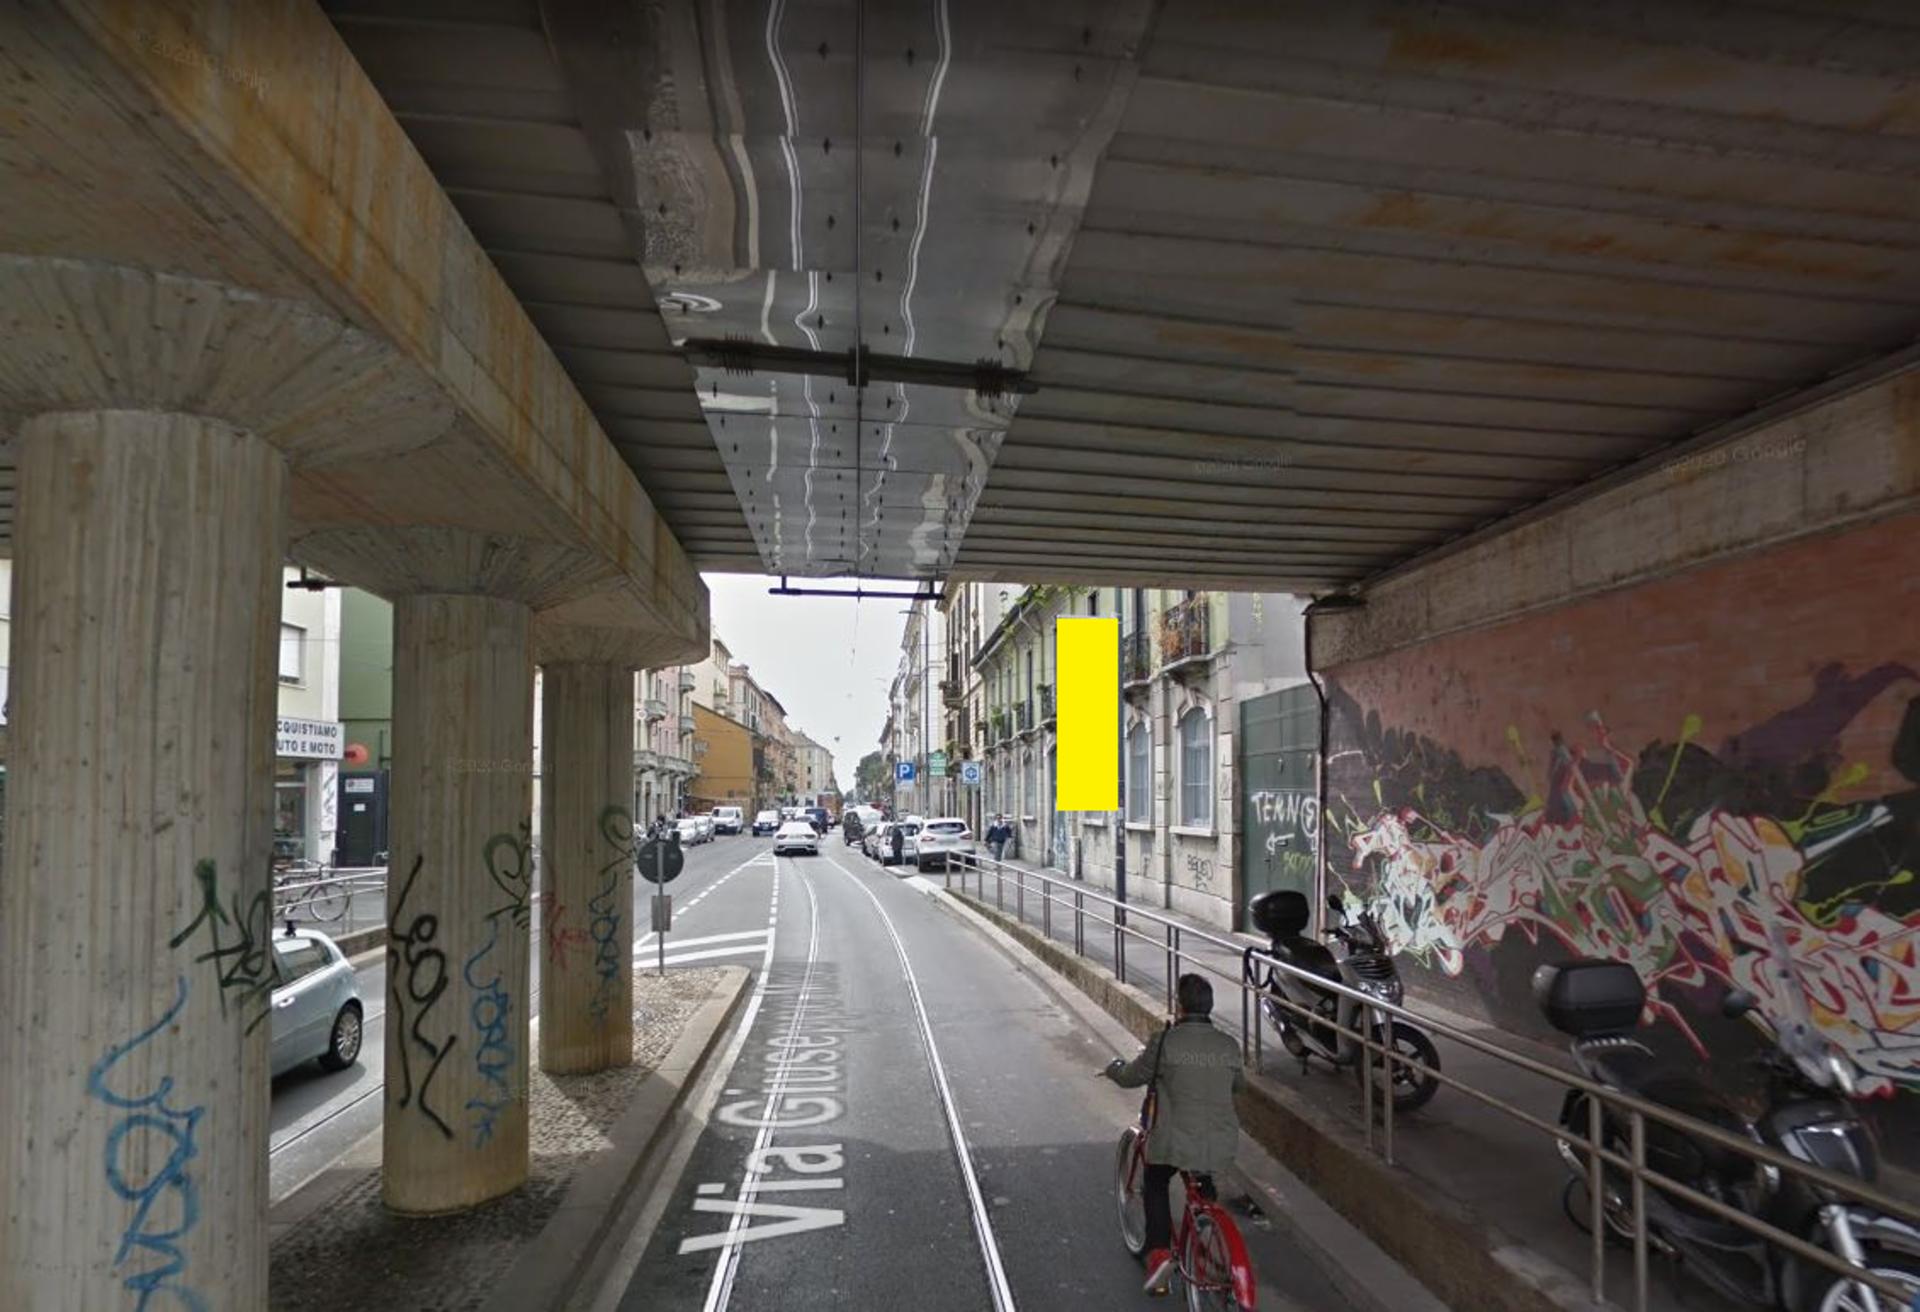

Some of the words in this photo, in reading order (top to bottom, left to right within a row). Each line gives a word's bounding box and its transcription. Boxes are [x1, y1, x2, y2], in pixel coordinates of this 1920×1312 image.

[301, 741, 306, 752] E
[309, 742, 336, 754] MOTO
[899, 764, 911, 778] P
